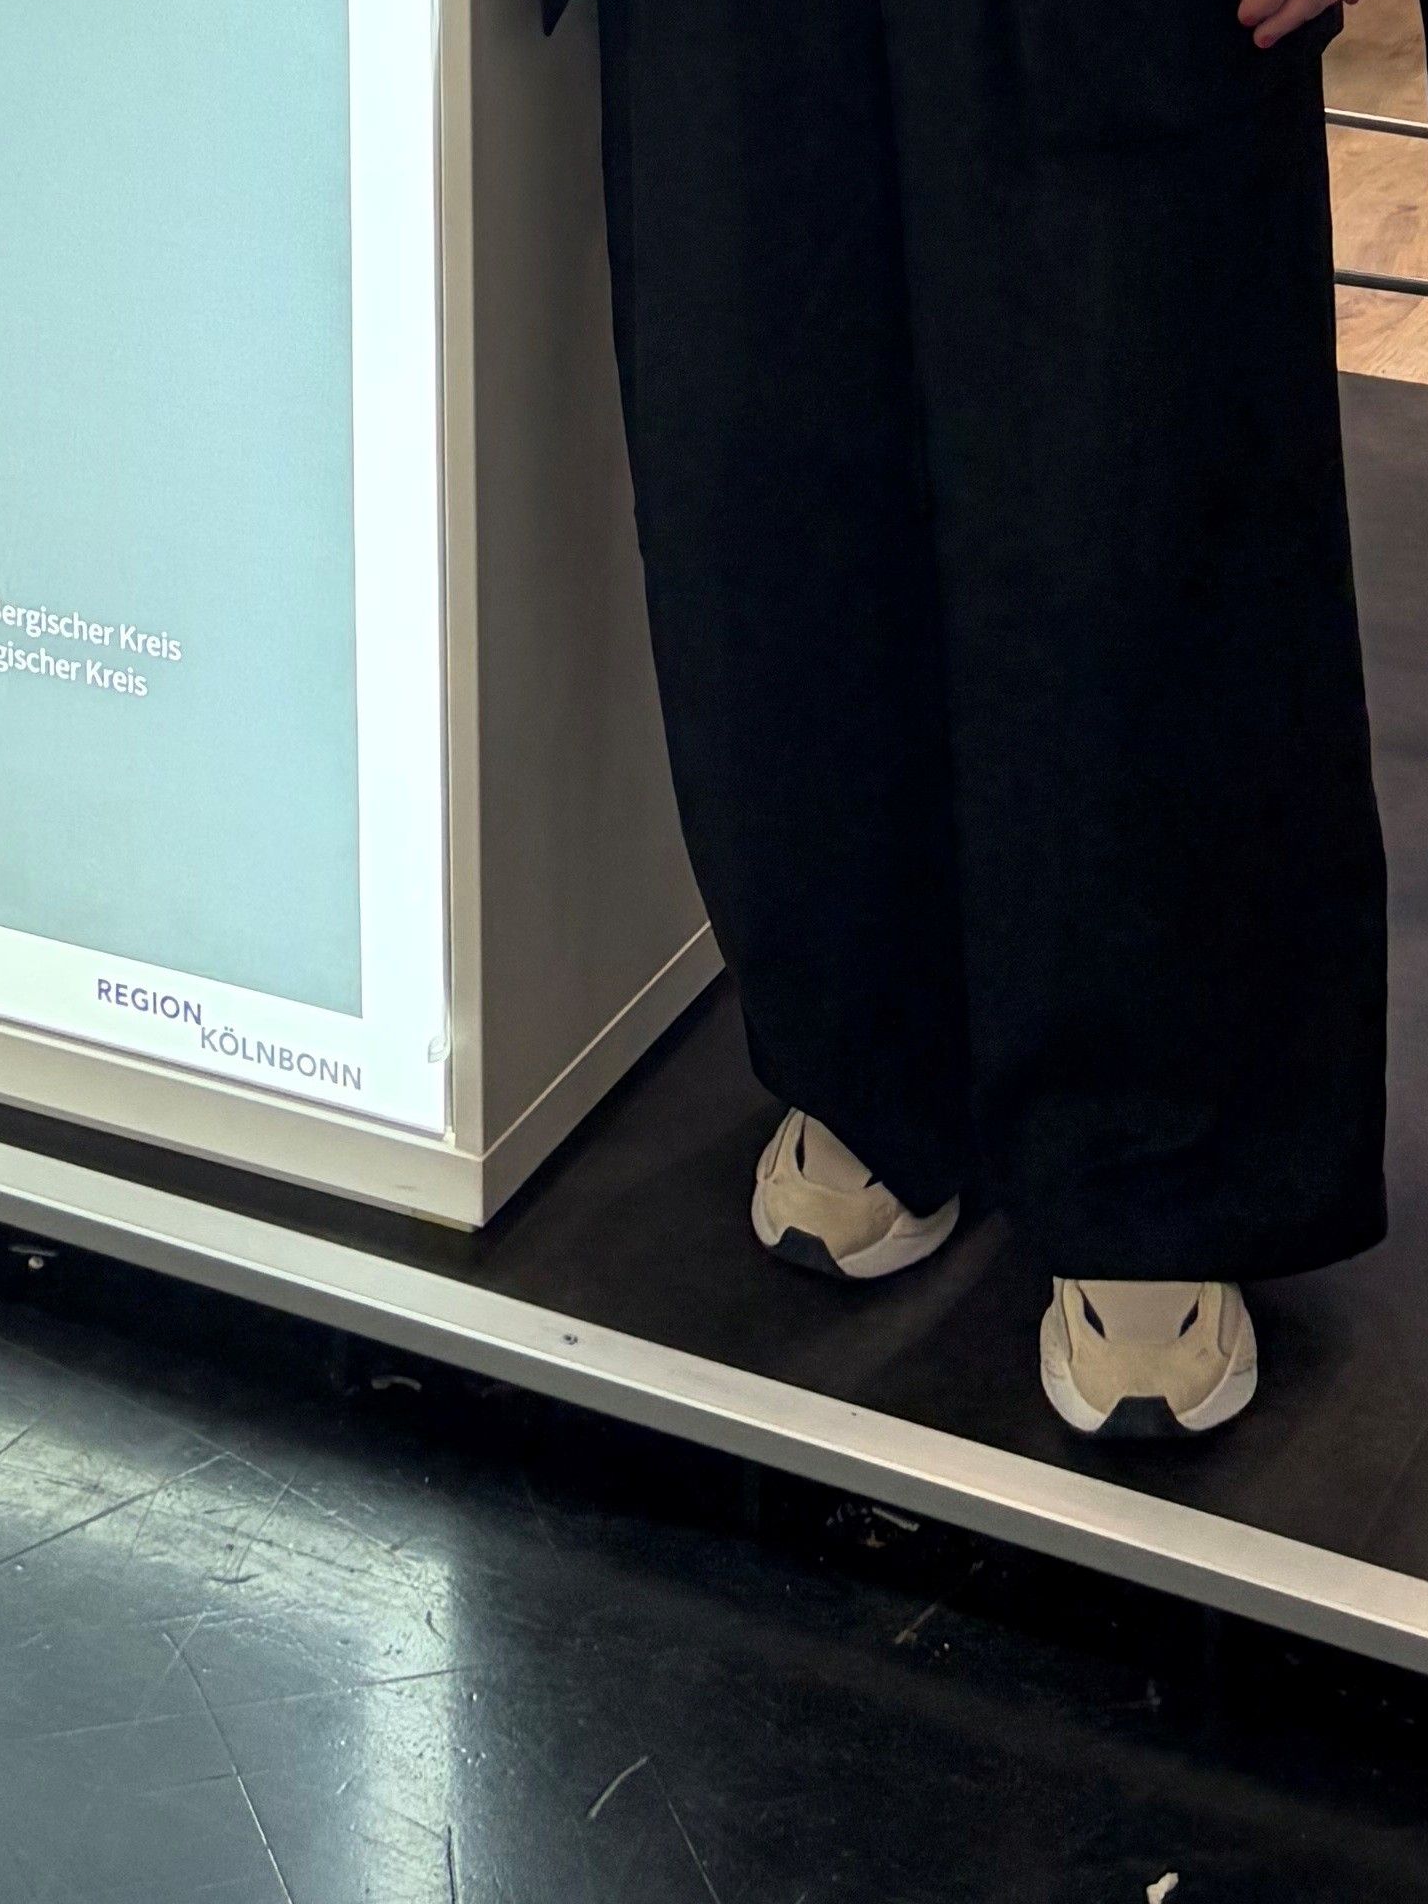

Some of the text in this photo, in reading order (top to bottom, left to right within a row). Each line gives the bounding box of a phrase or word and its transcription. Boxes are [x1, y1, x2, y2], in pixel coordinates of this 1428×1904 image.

[119, 624, 183, 661] Kreis
[85, 658, 149, 698] Kreis
[97, 978, 202, 1026] REGION
[200, 1025, 362, 1091] KÖLNBONN
